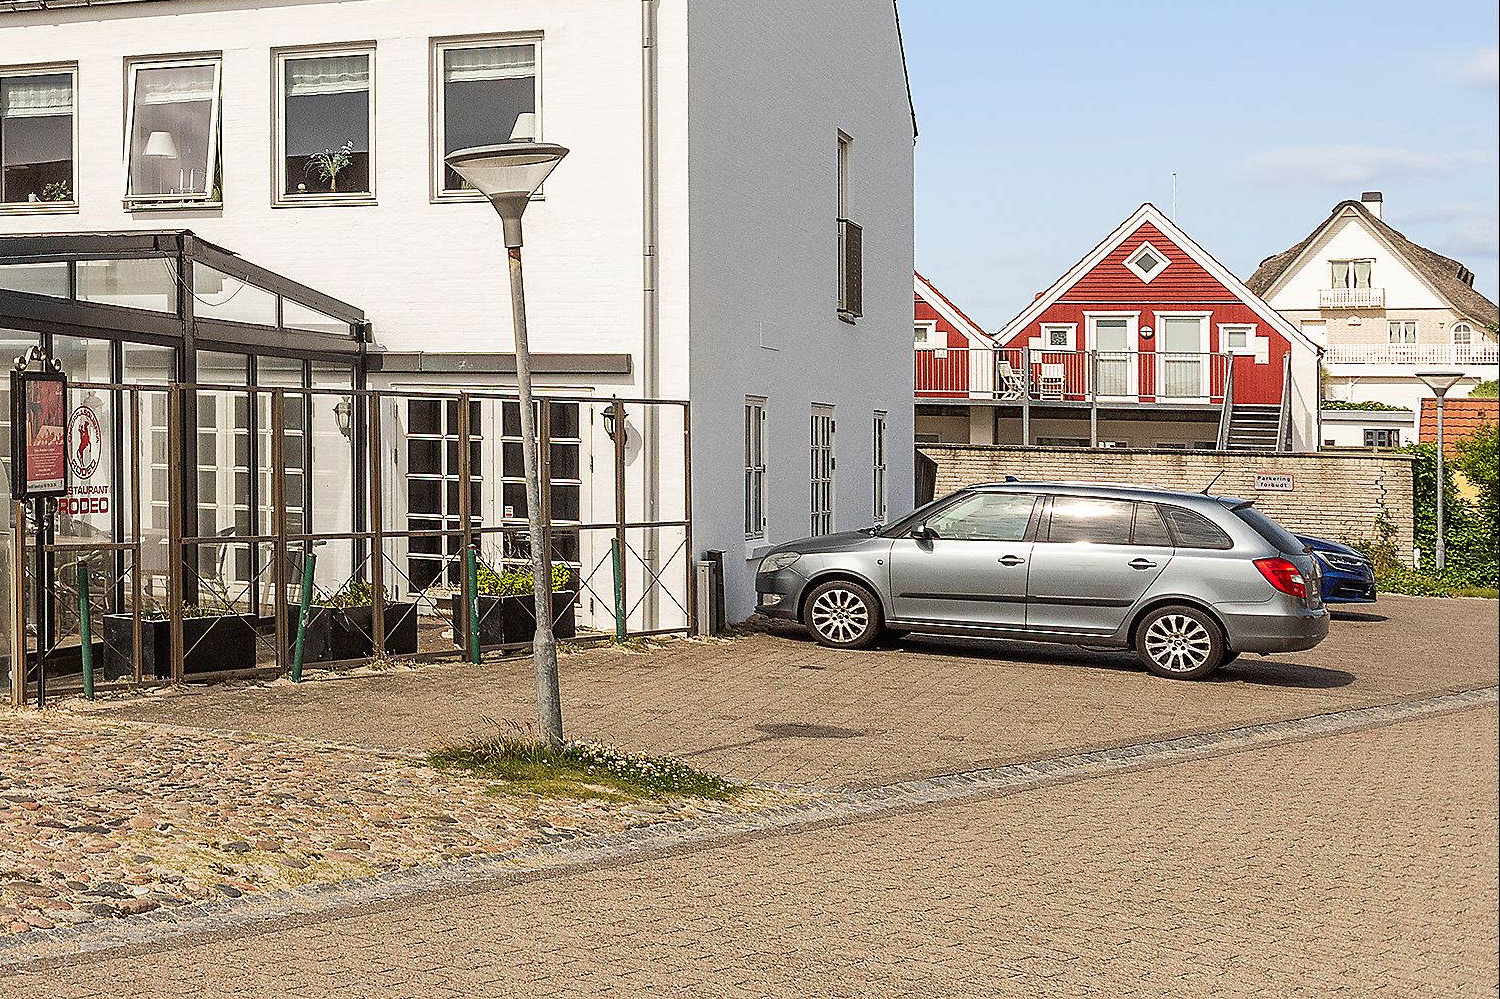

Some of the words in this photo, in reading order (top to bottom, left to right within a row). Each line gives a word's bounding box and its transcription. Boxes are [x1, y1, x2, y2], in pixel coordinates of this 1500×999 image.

[72, 459, 96, 476] RODEO
[67, 485, 109, 495] STAURANT
[58, 497, 109, 515] RODEO
